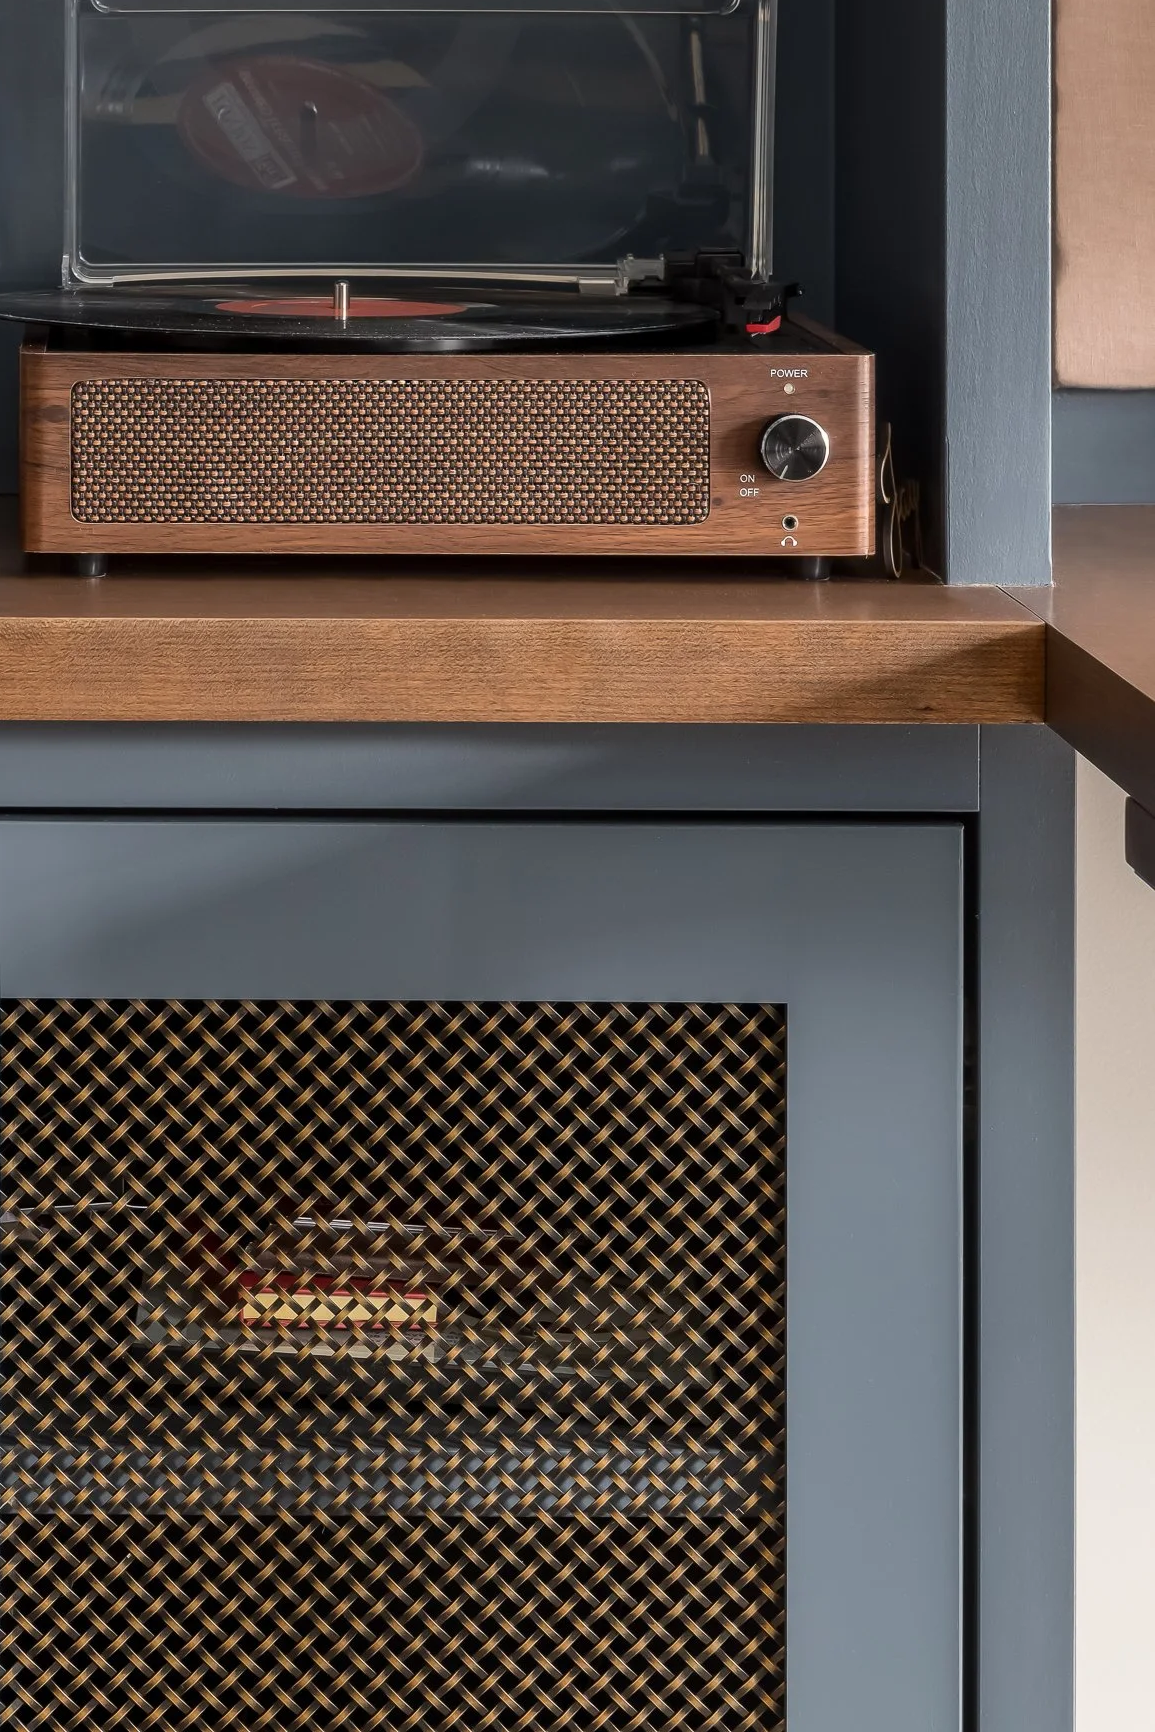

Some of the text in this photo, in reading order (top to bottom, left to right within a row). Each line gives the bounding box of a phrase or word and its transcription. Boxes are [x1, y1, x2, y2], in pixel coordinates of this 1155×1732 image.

[770, 369, 808, 378] POWER
[739, 474, 755, 483] ON
[739, 488, 760, 497] OFF
